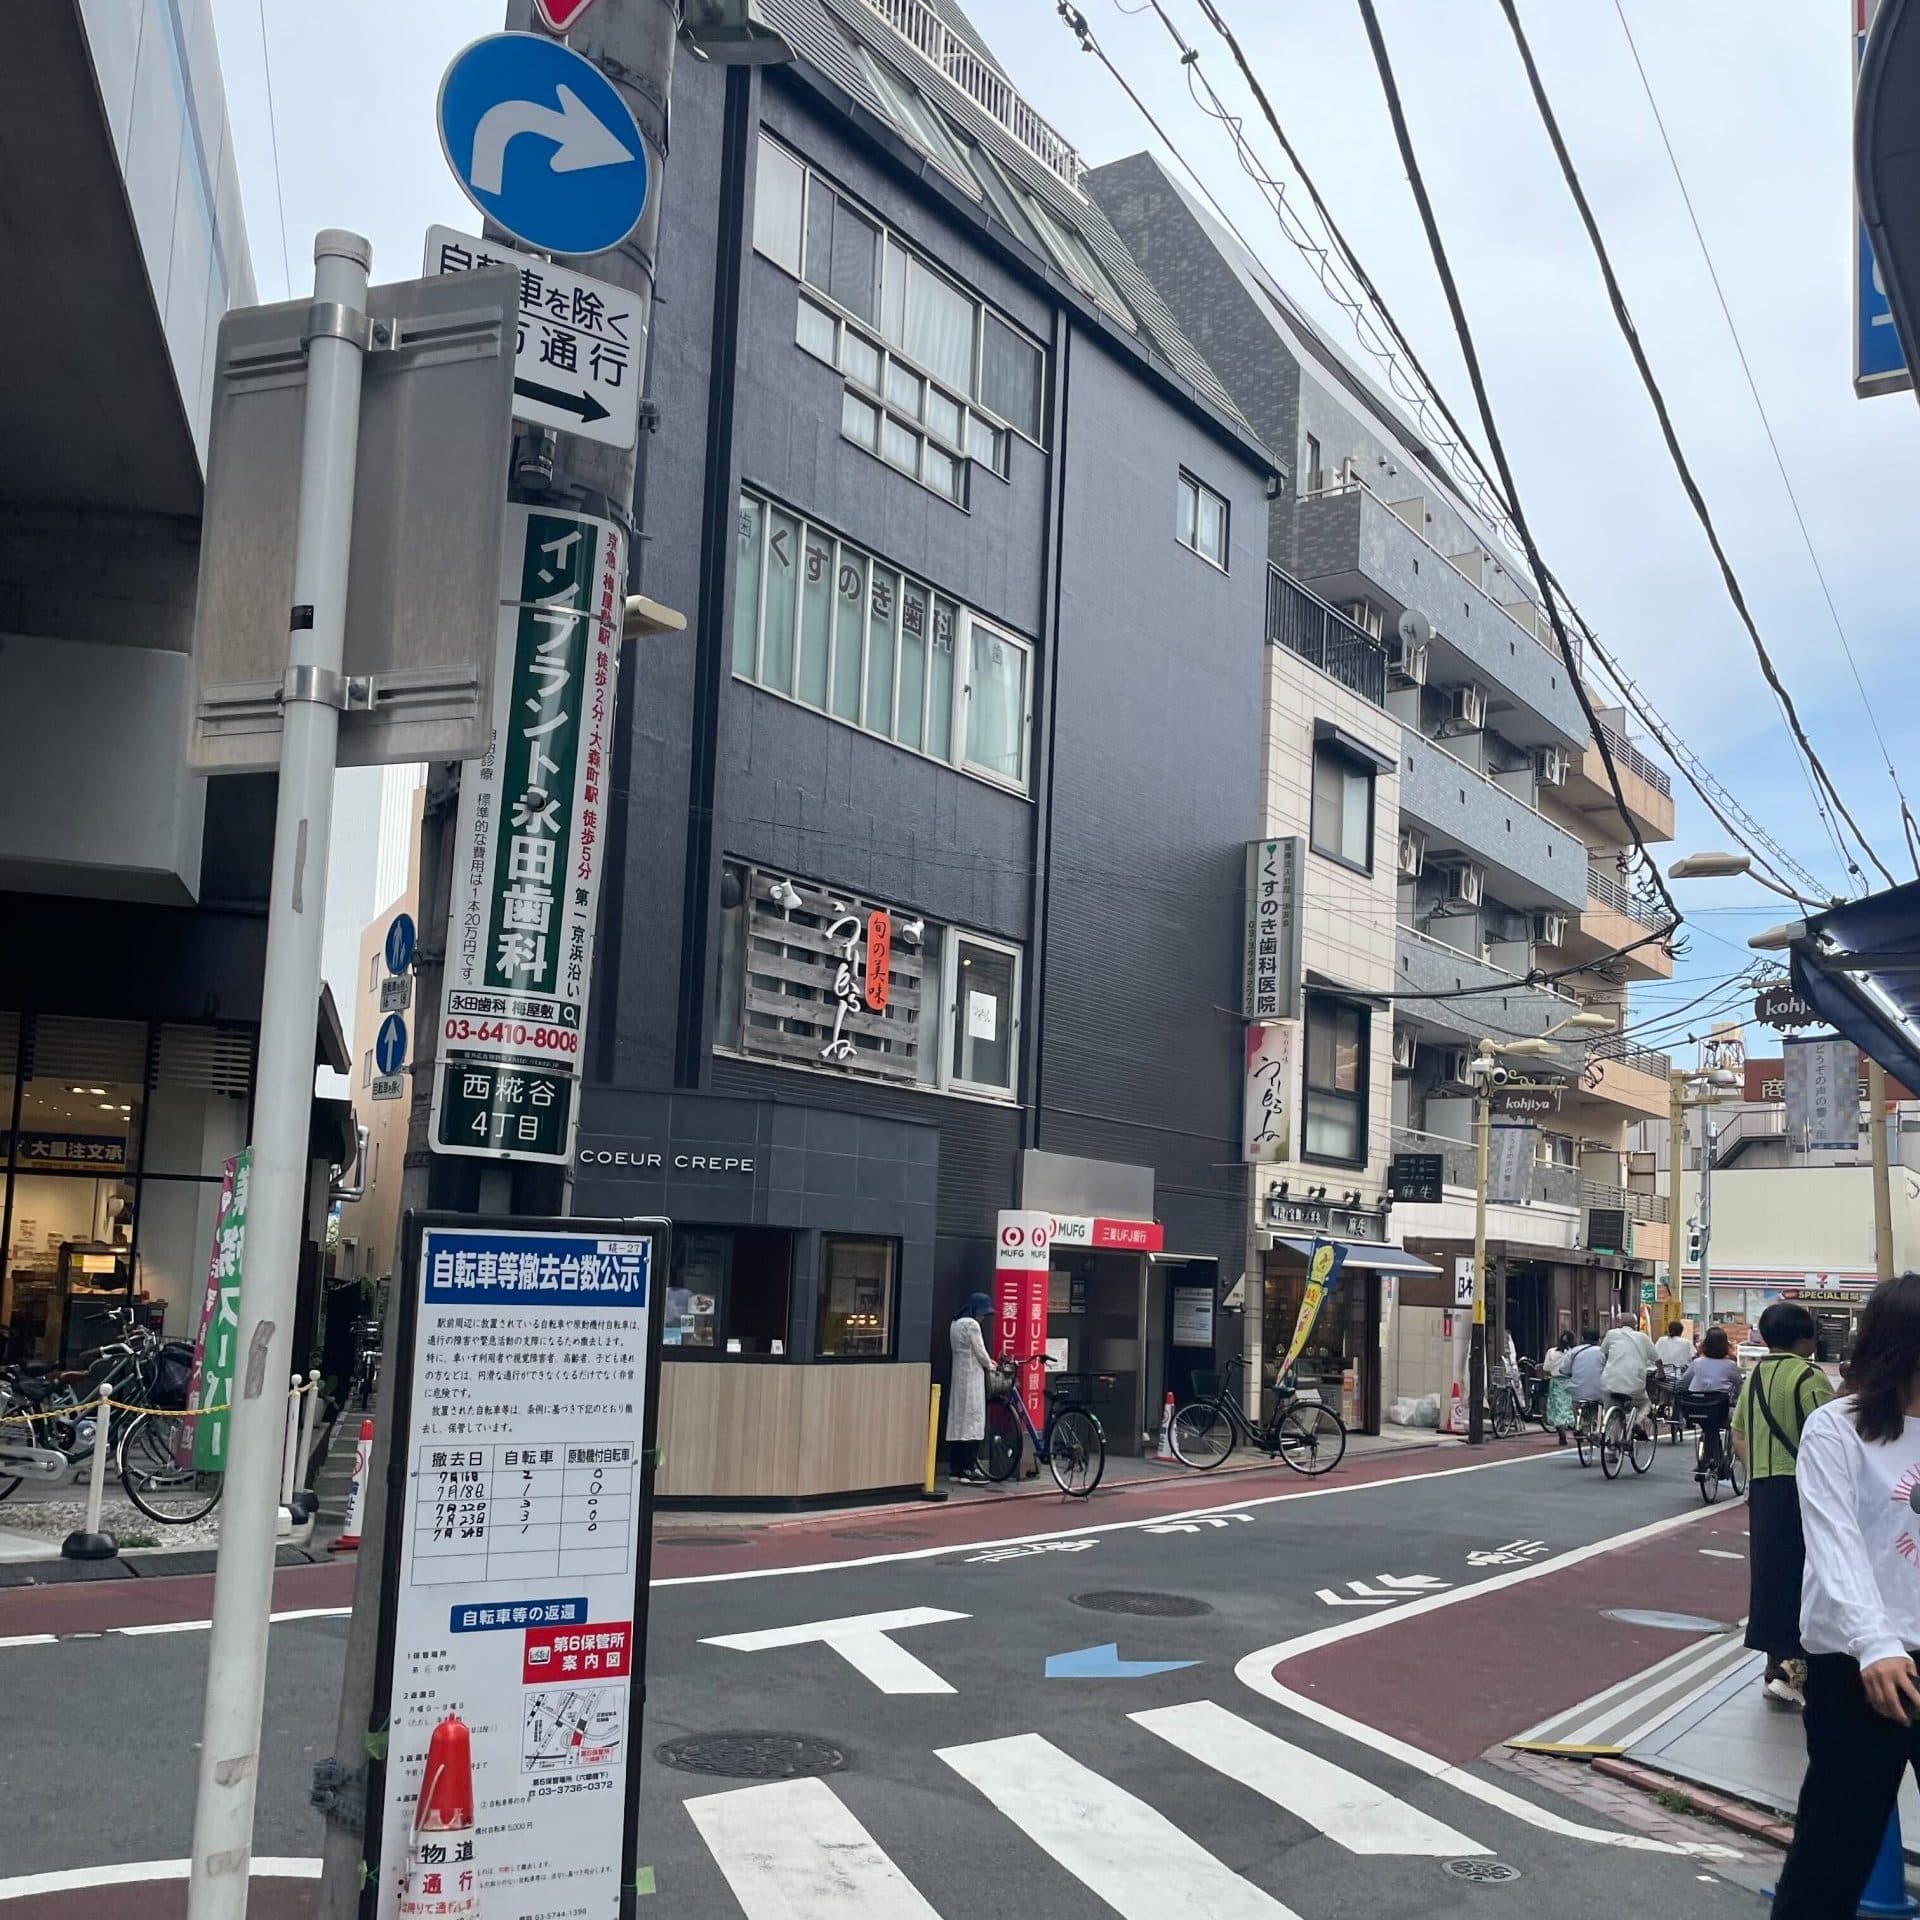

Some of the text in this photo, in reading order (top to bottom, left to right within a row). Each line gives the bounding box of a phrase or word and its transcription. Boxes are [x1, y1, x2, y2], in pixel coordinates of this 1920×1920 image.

[566, 887, 590, 998] 第一京浜沿い
[1257, 860, 1280, 1014] くすのき歯科医院
[867, 917, 887, 1004] 旬の美味
[451, 995, 554, 1020] 永田歯科 梅屋敷
[1766, 997, 1811, 1015] kohj
[445, 1020, 578, 1053] 03-6410-8008
[463, 1074, 555, 1107] 西糀谷
[1505, 1097, 1550, 1111] kohjiya
[472, 1111, 538, 1141] 4丁目
[580, 1150, 754, 1171] COEUR CREPE
[1058, 1223, 1085, 1238] MUFG
[1103, 1227, 1147, 1243] 三菱UFJ銀行
[1000, 1249, 1024, 1258] MUFG
[1031, 1250, 1047, 1259] MUFG
[433, 1249, 640, 1292] 自転車等撤去台数公示
[1798, 1290, 1840, 1300] SPECIAL
[424, 1387, 471, 1399] に危険です。
[421, 1423, 513, 1434] 去し、保管しています。
[432, 1451, 483, 1468] 撤去日
[505, 1450, 554, 1465] 自転車
[568, 1448, 630, 1463] 原動機付自転車
[522, 1469, 533, 1480] 2
[437, 1483, 484, 1501] 7月18日
[590, 1481, 603, 1495] 0
[435, 1502, 486, 1516] 7月22日
[435, 1512, 485, 1528] 7月23日
[520, 1510, 530, 1521] 3
[463, 1604, 576, 1626] 自転車等の返還
[553, 1632, 625, 1652] 第6保管所
[562, 1651, 621, 1672] 案内図
[538, 1781, 613, 1796] 03-3736-0372
